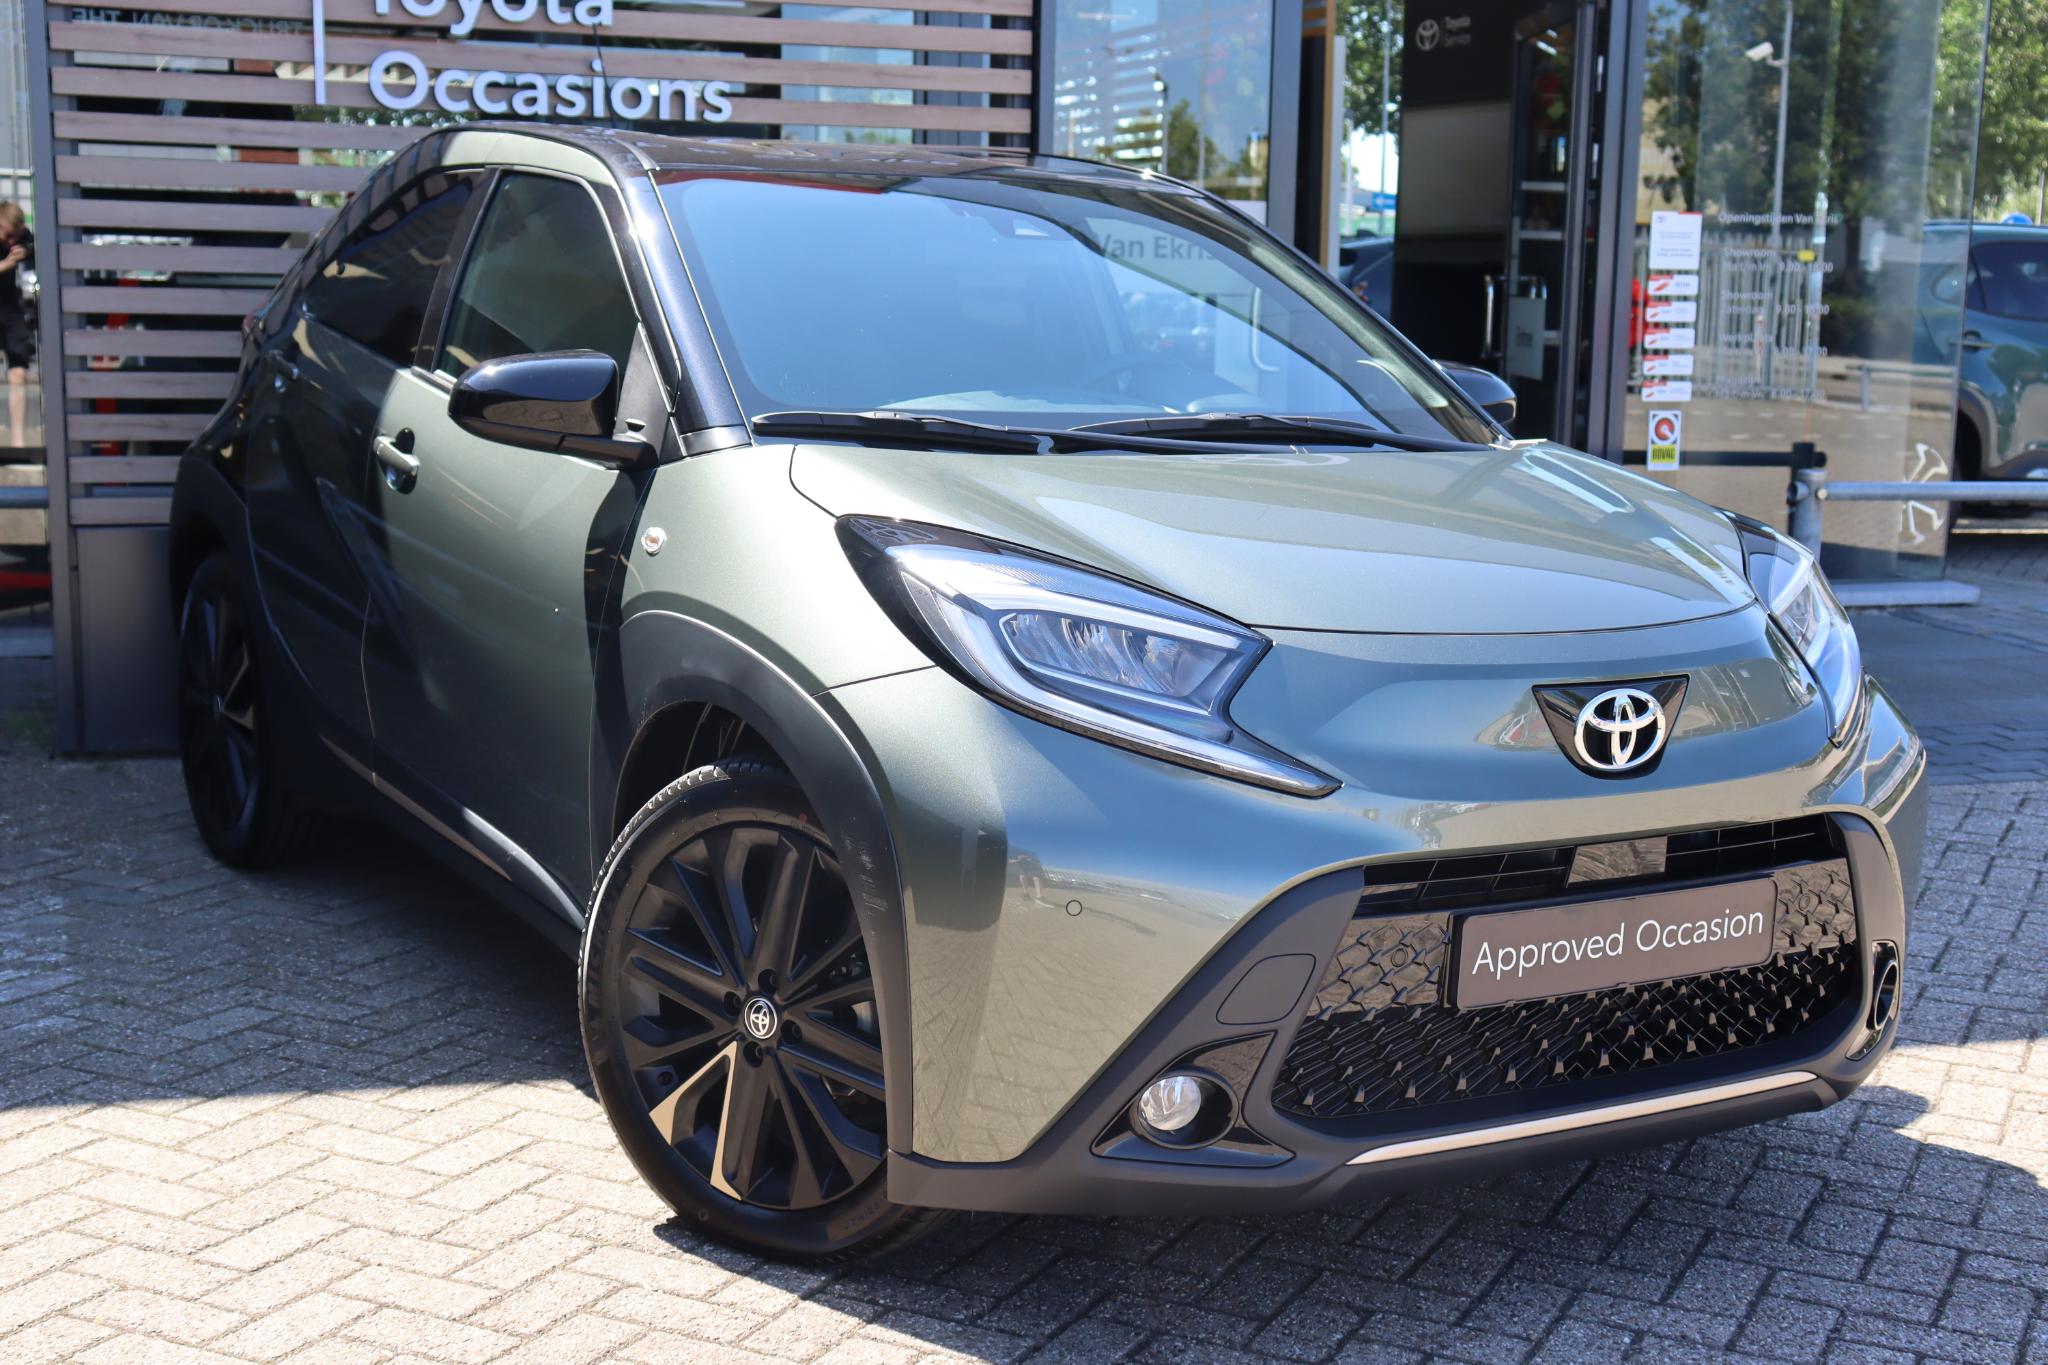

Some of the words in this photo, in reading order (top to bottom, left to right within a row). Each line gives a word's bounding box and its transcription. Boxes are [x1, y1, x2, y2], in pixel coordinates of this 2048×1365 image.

[377, 0, 613, 36] yota
[368, 50, 732, 122] Occasions
[1472, 922, 1625, 980] Approved
[1635, 908, 1763, 952] Occasion
